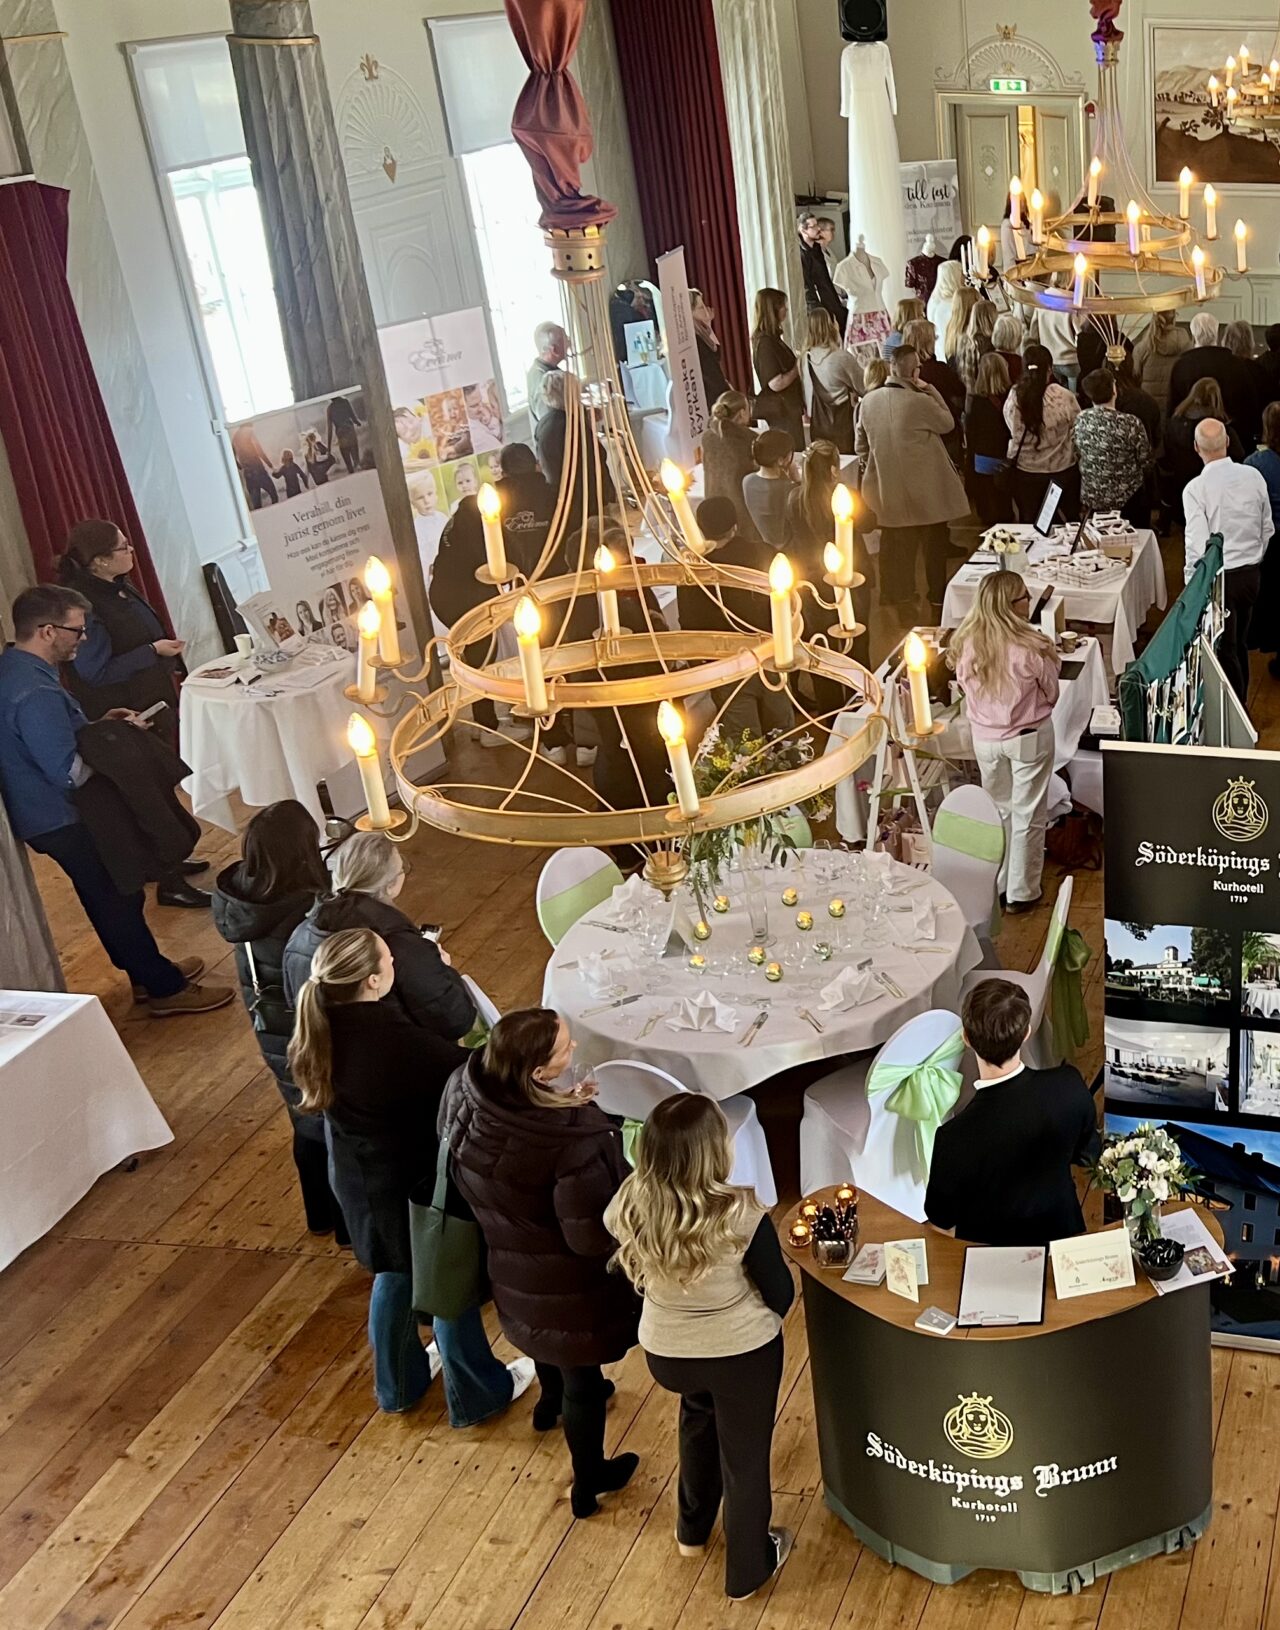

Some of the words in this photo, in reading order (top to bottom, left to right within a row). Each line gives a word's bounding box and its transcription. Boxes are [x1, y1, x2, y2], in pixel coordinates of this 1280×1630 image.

[906, 179, 928, 201] till
[931, 184, 950, 201] fest
[681, 358, 696, 439] Svenska
[688, 368, 704, 435] kyrkan
[335, 496, 352, 509] din
[284, 527, 310, 547] jurist
[312, 515, 345, 536] genom
[345, 506, 366, 520] livet
[1135, 841, 1270, 877] Söderköpings
[1213, 880, 1264, 894] Kurhotell
[1230, 895, 1248, 903] 1719
[866, 1431, 1024, 1498] Söderköpings
[1032, 1455, 1118, 1498] Brunn
[951, 1496, 1018, 1513] Kurhotell
[975, 1513, 997, 1523] 1719
